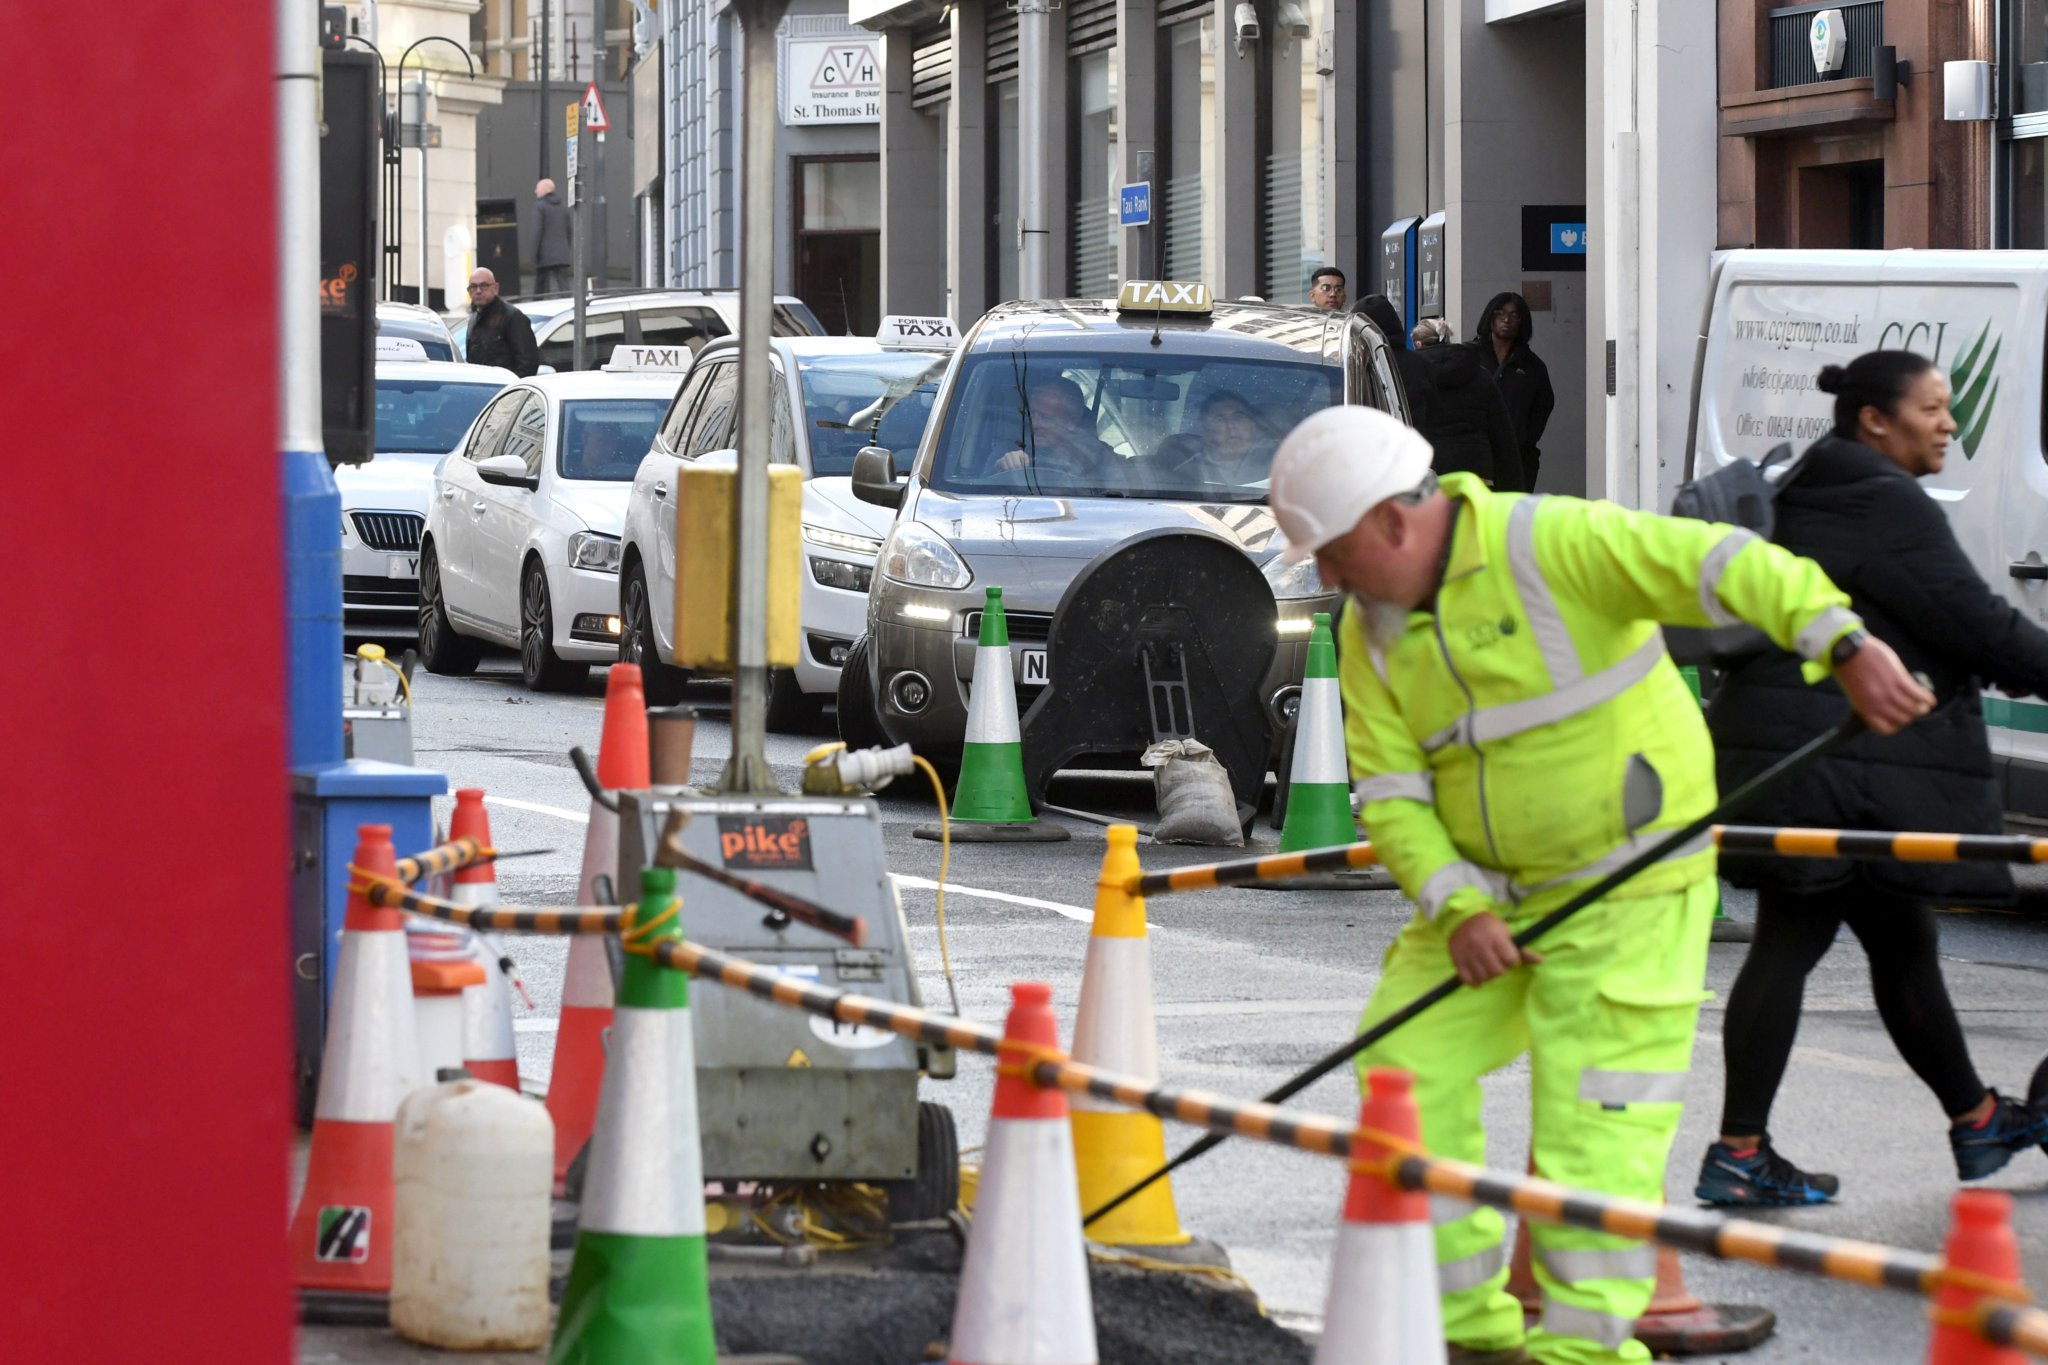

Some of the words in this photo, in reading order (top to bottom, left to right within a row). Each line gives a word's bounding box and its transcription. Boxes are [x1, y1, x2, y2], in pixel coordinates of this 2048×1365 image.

[811, 91, 849, 99] Insurance
[793, 105, 810, 119] St.
[813, 104, 862, 117] Thomas
[1122, 197, 1133, 214] Taxi
[1134, 195, 1148, 212] Rank
[1126, 282, 1205, 305] TAXI
[892, 324, 952, 337] TAXI
[1736, 312, 1860, 351] www.ccjgroup.co.uk
[631, 349, 679, 366] TAXI
[1767, 415, 1793, 438] 01624
[721, 825, 800, 859] pike
